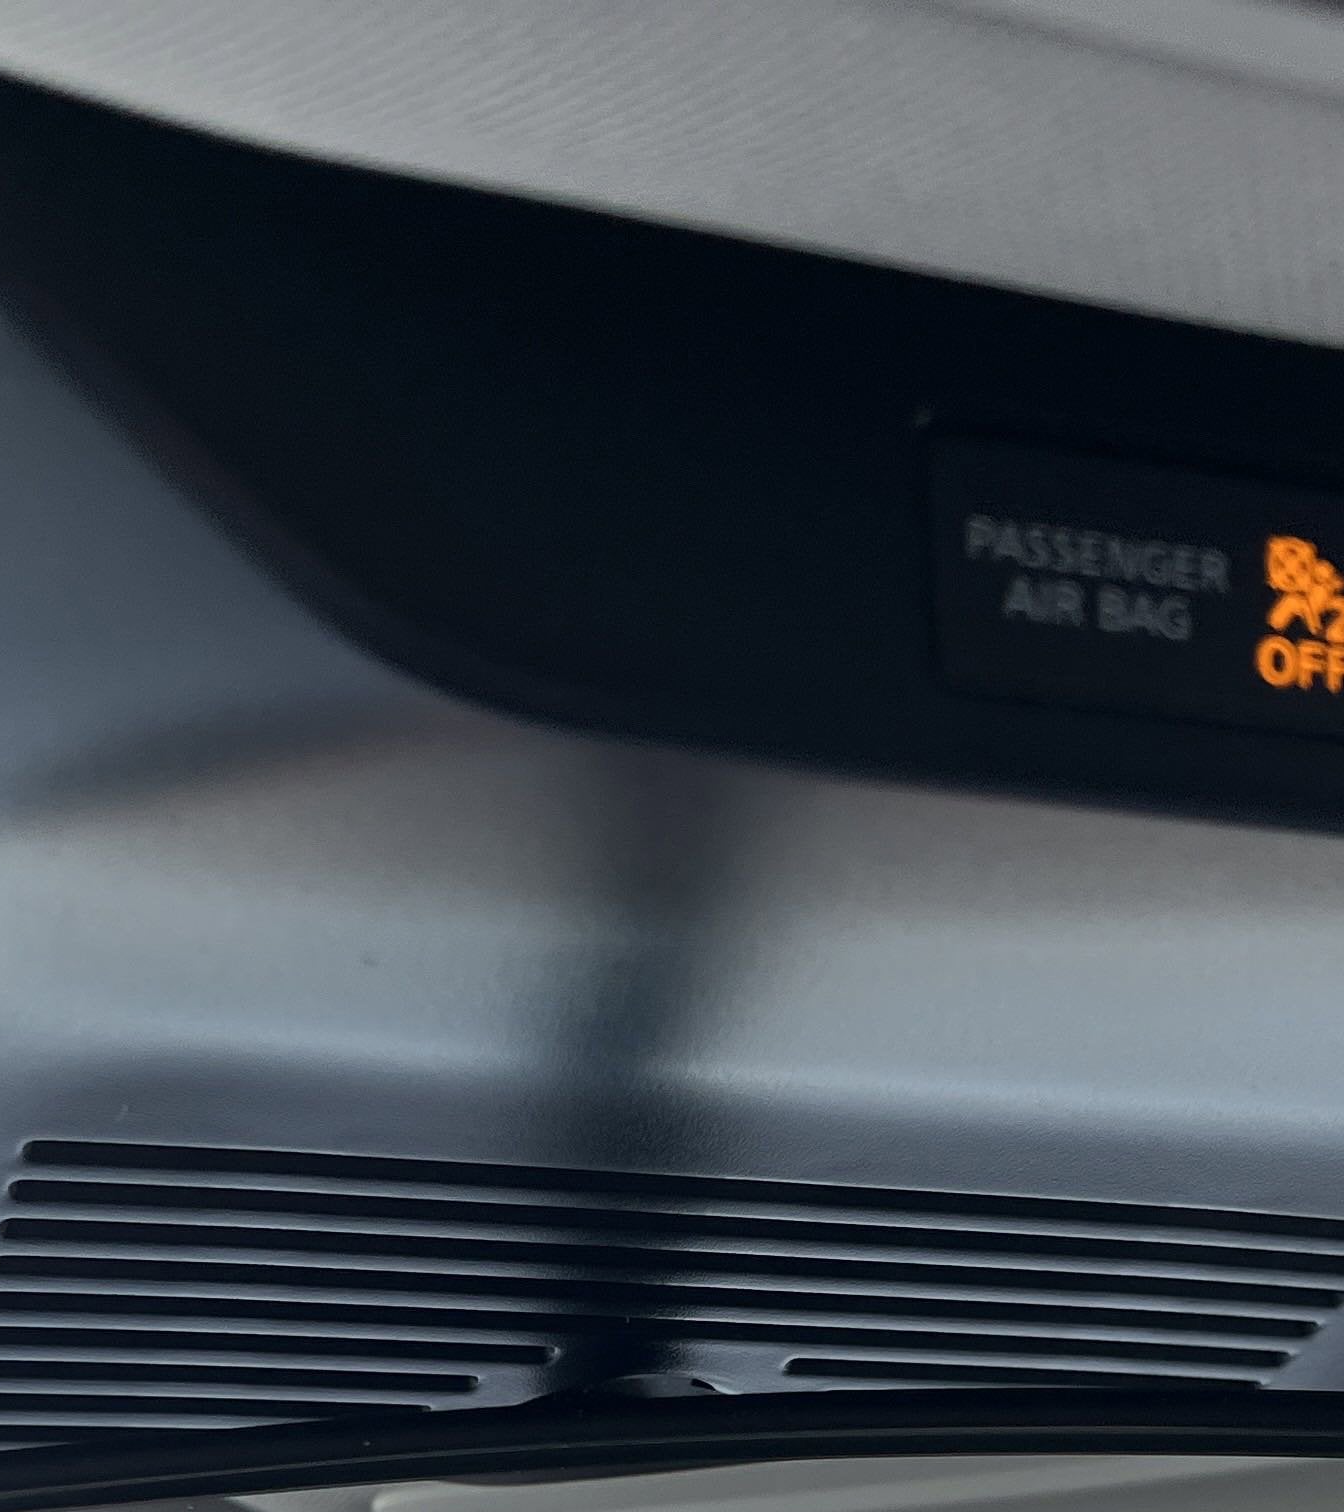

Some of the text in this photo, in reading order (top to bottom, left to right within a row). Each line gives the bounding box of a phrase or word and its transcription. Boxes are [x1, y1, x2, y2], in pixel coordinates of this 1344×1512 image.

[966, 514, 1231, 593] PASSENGER
[1003, 577, 1193, 640] AIR BAG
